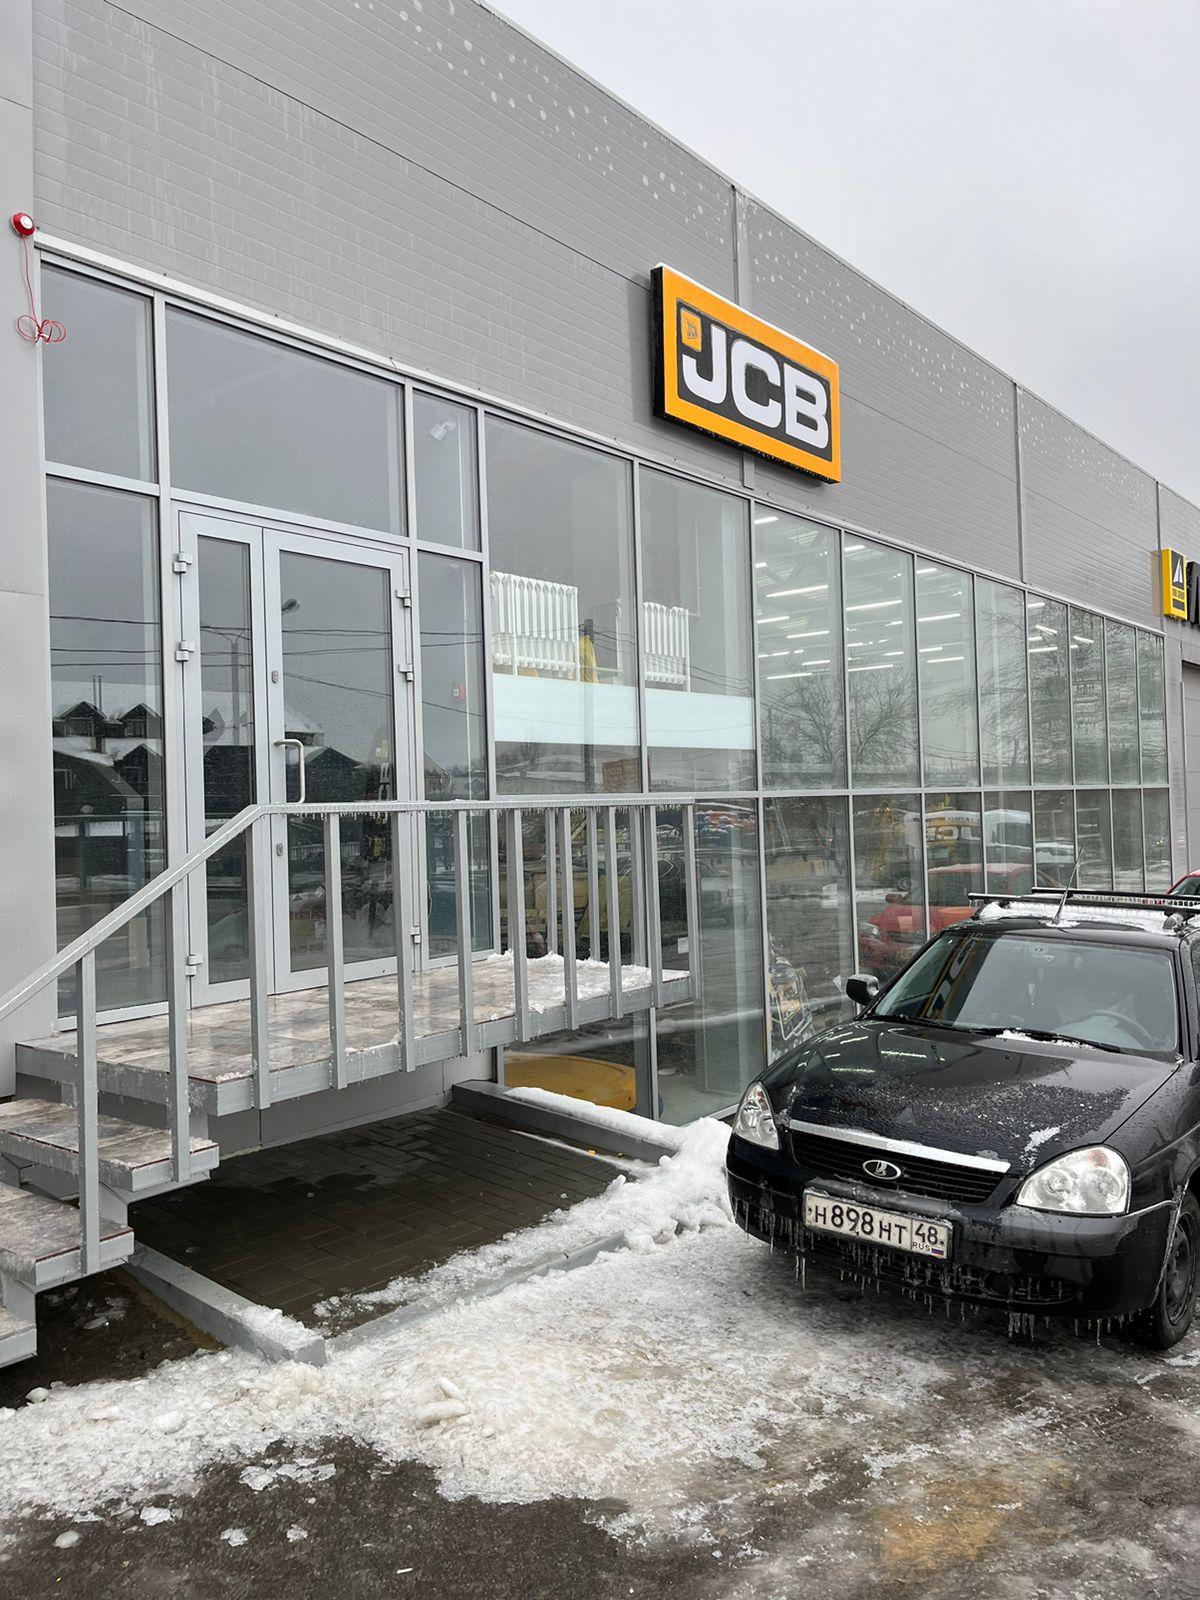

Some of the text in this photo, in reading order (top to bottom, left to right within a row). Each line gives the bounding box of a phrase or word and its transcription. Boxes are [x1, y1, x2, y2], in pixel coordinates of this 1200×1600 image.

[682, 324, 829, 449] JCB
[915, 1224, 938, 1245] 48
[912, 1241, 931, 1252] RUS
